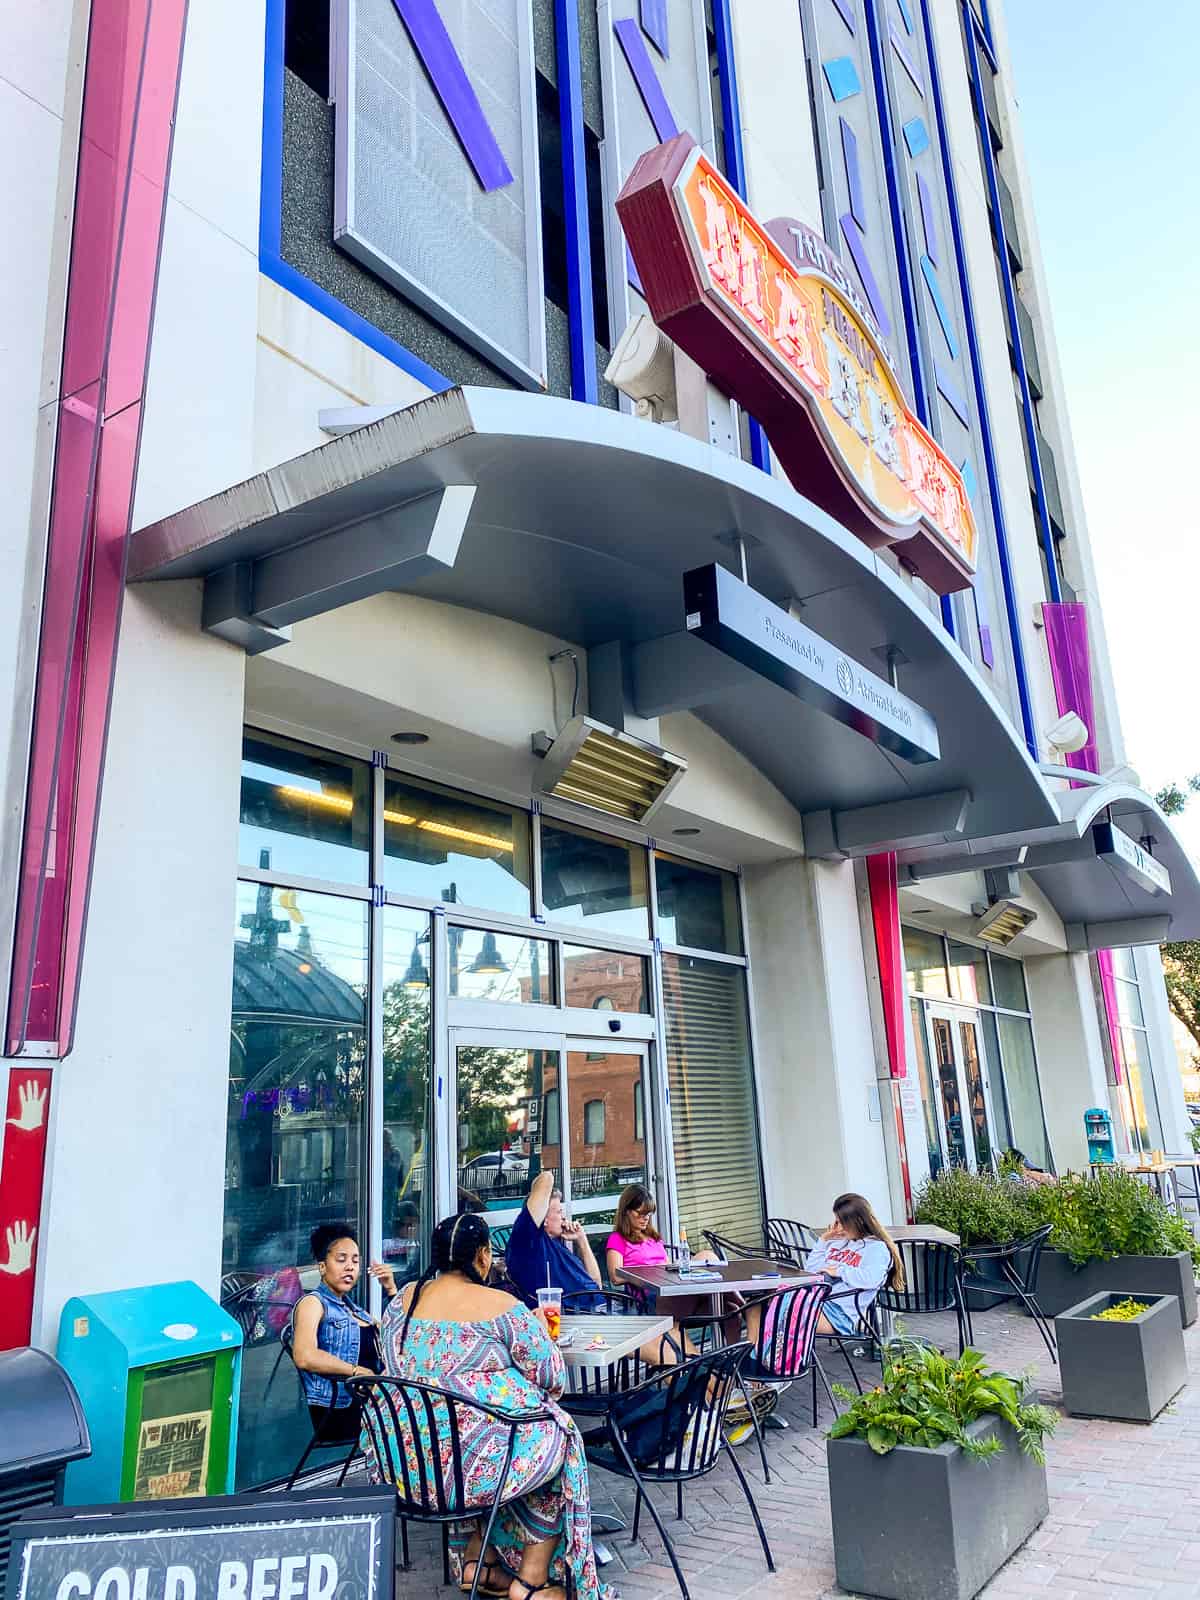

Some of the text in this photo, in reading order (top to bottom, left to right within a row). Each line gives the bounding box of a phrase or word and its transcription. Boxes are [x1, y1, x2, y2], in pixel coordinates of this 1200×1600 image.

[788, 227, 829, 276] 7th
[763, 617, 812, 663] Presented
[217, 1553, 338, 1600] BEER
